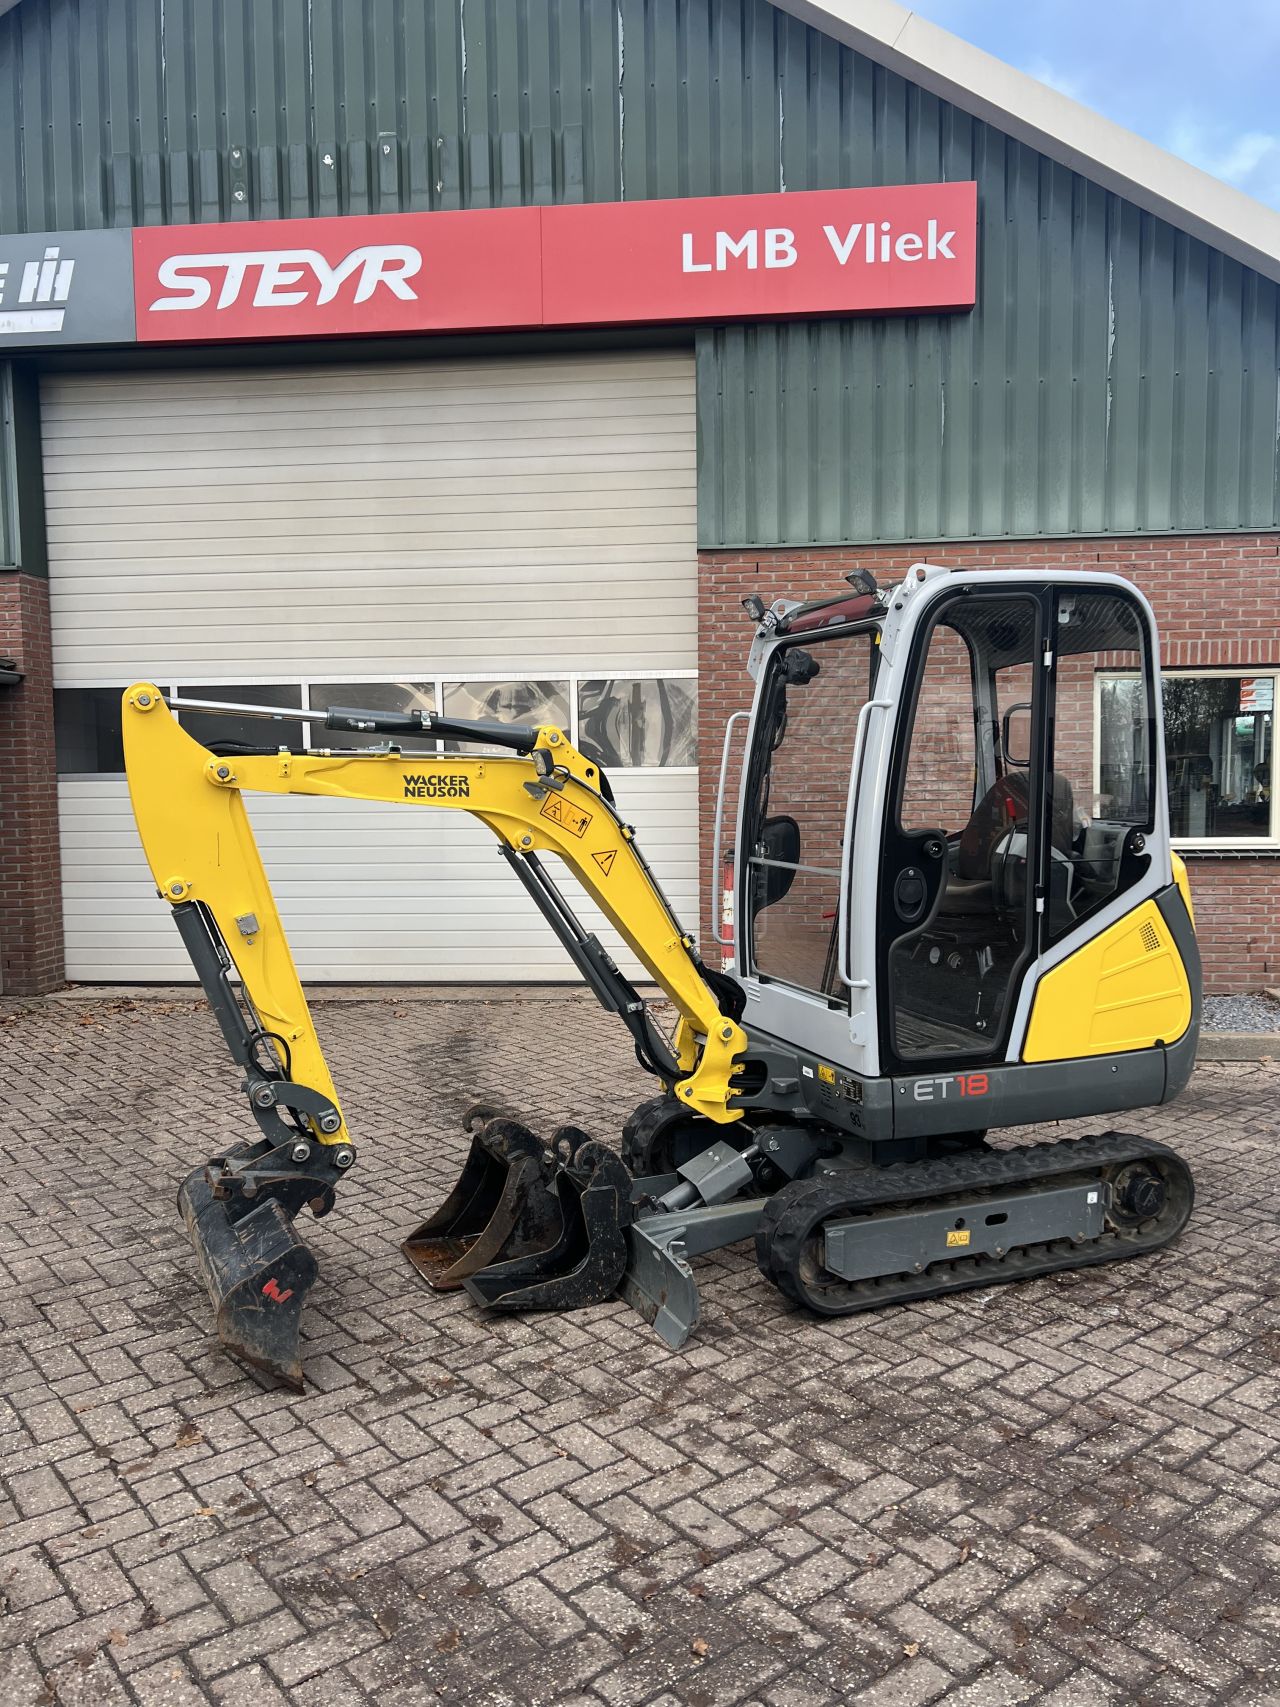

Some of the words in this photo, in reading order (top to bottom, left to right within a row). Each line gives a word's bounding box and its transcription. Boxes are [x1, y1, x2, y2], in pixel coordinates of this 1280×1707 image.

[682, 228, 798, 273] LMB
[822, 219, 957, 266] Vliek
[149, 244, 422, 311] STEYR
[403, 774, 469, 786] WACKER
[404, 786, 470, 798] NEUSON
[913, 1073, 989, 1101] ET18
